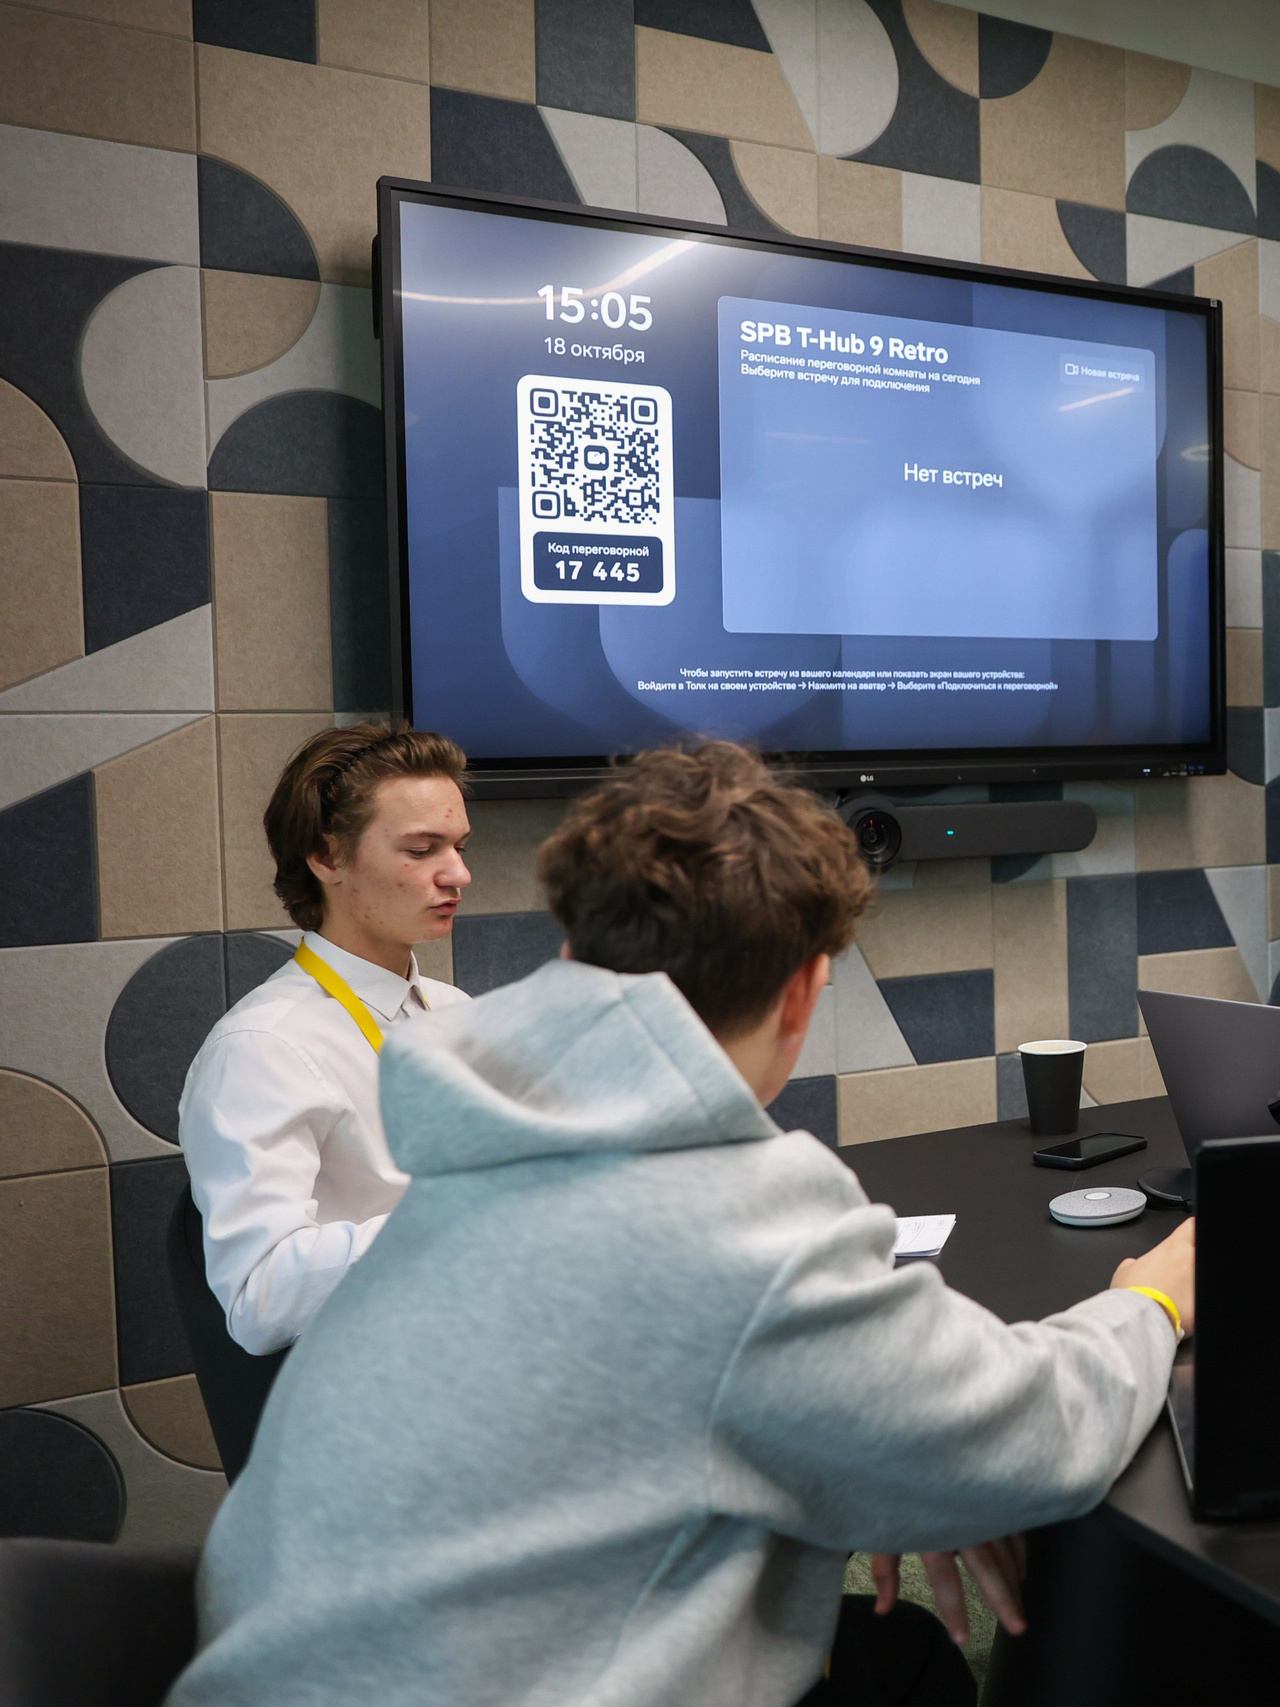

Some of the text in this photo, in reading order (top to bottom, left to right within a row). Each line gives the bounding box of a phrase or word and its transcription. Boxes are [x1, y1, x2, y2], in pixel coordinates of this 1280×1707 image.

[537, 284, 653, 331] 15:05
[544, 336, 645, 365] 18 октября
[740, 320, 949, 364] SPB T-Hub 9 Retro
[740, 349, 981, 386] Расписание переговорной комнаты на сегодня
[740, 363, 931, 394] Выберите встречу для подключения
[1080, 365, 1140, 382] Новая встреча
[904, 463, 1003, 490] Нет встреч
[547, 542, 650, 558] Код переговорной
[555, 560, 641, 582] 17 445
[637, 680, 677, 692] Войдите
[678, 682, 684, 690] в
[685, 681, 707, 690] Толк
[708, 682, 719, 690] на
[720, 682, 748, 690] своем
[748, 681, 797, 692] устройстве
[807, 681, 847, 691] Нажмите
[847, 682, 858, 691] на
[858, 682, 886, 692] аватар
[896, 681, 936, 692] Выберите
[937, 681, 997, 692] «Подключиться
[1003, 681, 1059, 692] переговорной»
[679, 667, 1025, 681] Чтобы запустить встречу из вашего календаря или показать экран вашего устройства:
